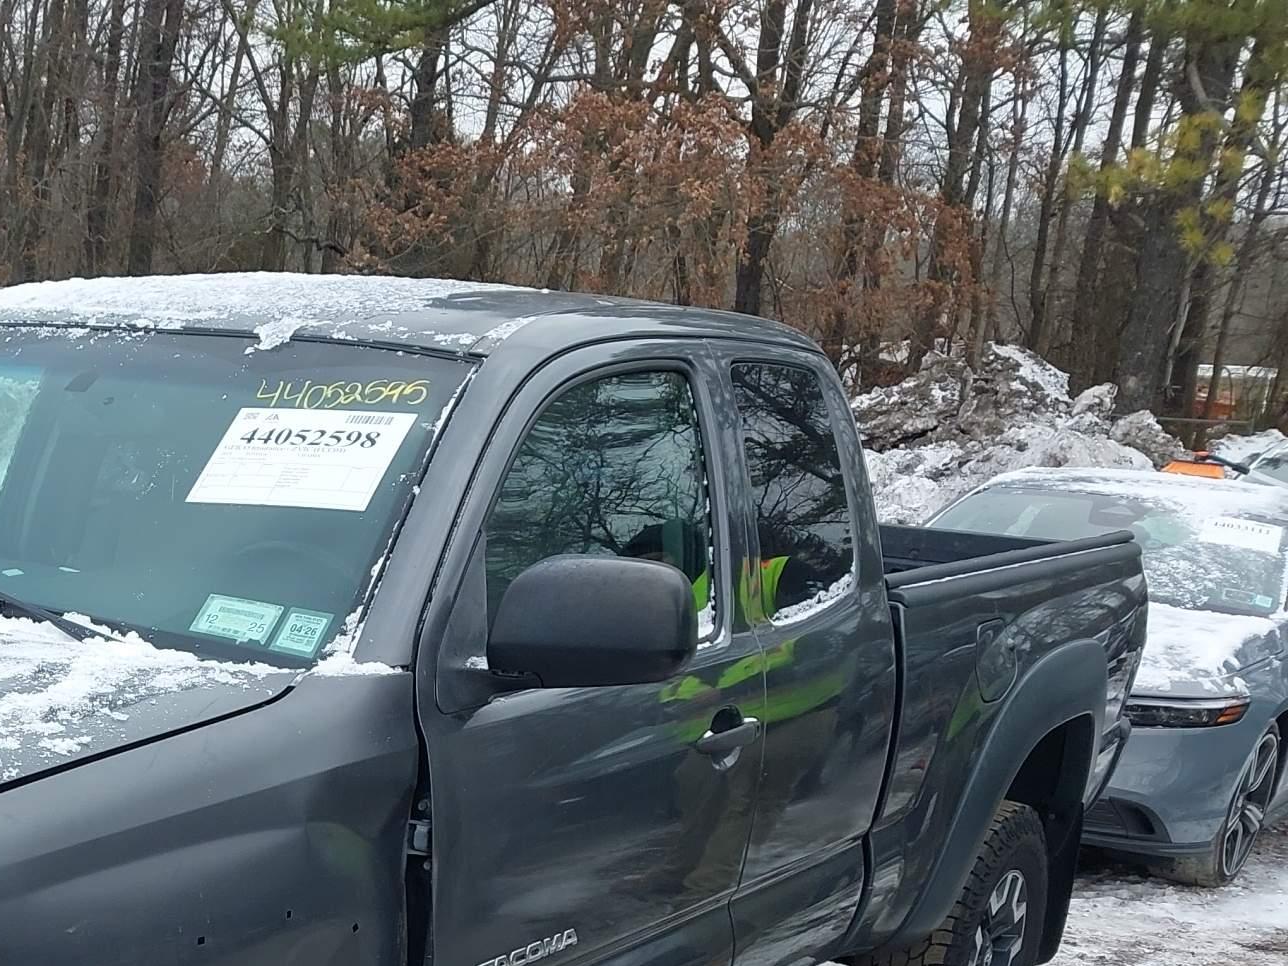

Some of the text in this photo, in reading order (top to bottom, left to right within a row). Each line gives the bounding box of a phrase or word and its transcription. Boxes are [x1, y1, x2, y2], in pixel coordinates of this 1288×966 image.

[240, 427, 381, 449] 44052598
[205, 613, 219, 624] 12
[248, 622, 266, 633] 25
